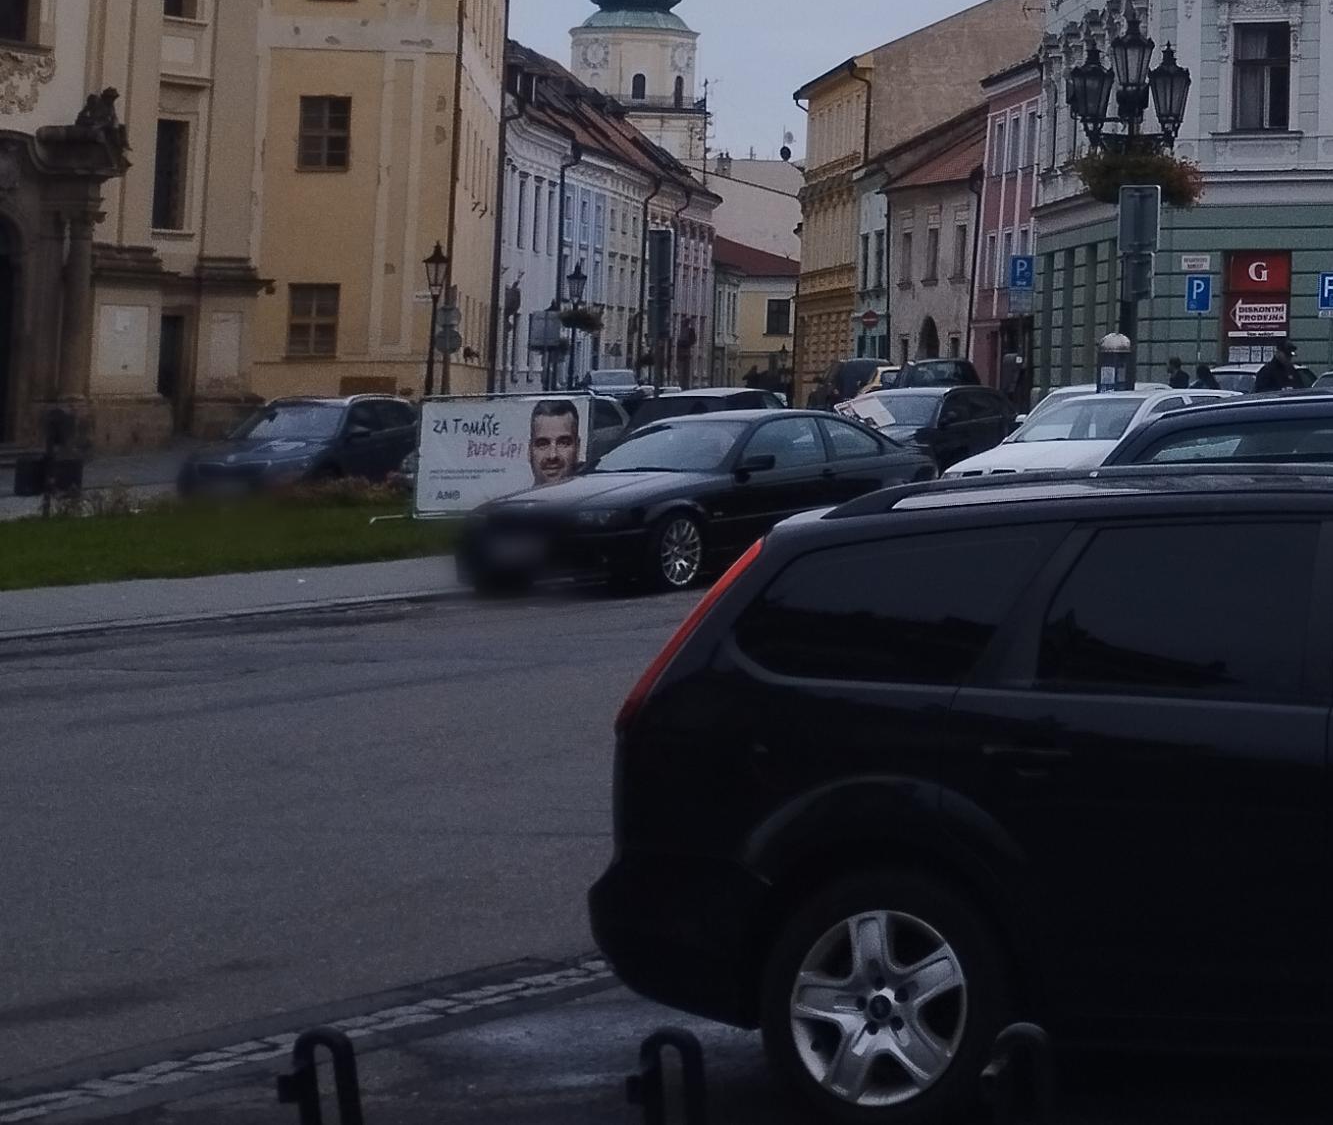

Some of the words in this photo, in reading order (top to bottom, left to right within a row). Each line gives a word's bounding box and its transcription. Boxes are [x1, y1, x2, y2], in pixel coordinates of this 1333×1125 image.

[1016, 259, 1027, 277] P
[1248, 261, 1269, 282] G
[1193, 279, 1205, 299] P
[433, 419, 448, 434] ZA
[452, 413, 501, 438] TOMÁŠE
[467, 440, 497, 458] BUDE
